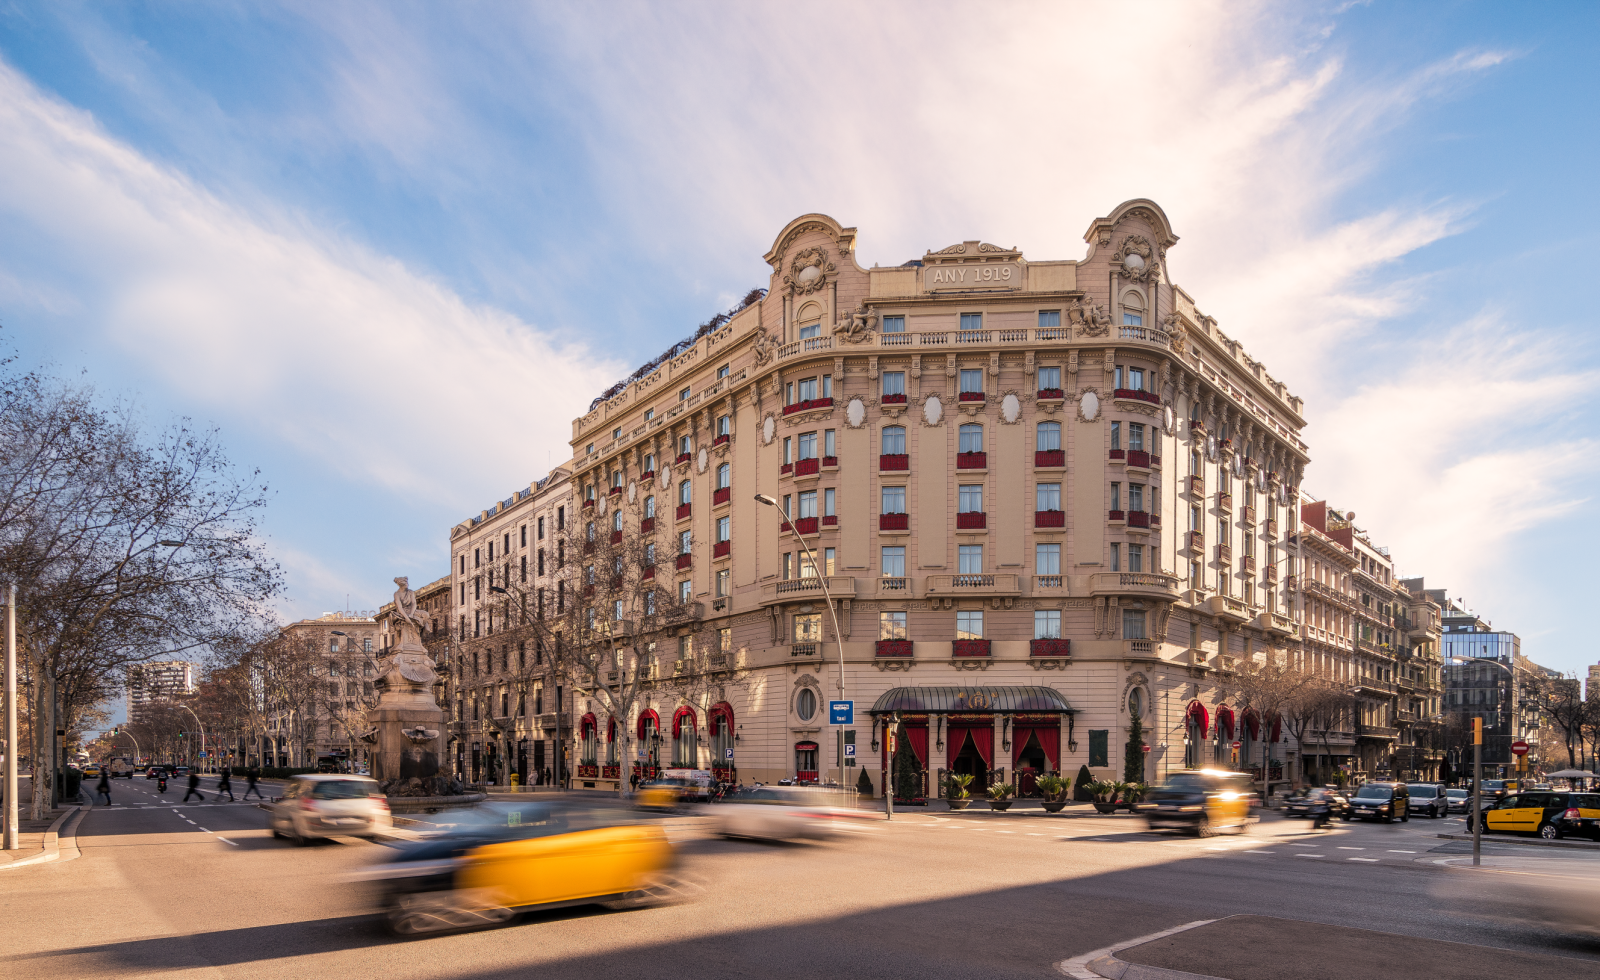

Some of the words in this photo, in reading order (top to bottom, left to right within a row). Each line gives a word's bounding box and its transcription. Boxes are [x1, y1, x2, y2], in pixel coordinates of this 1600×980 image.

[933, 268, 967, 283] ANY
[974, 267, 1012, 282] 1919
[336, 610, 377, 620] OCASO
[726, 749, 733, 758] P
[846, 745, 854, 755] P
